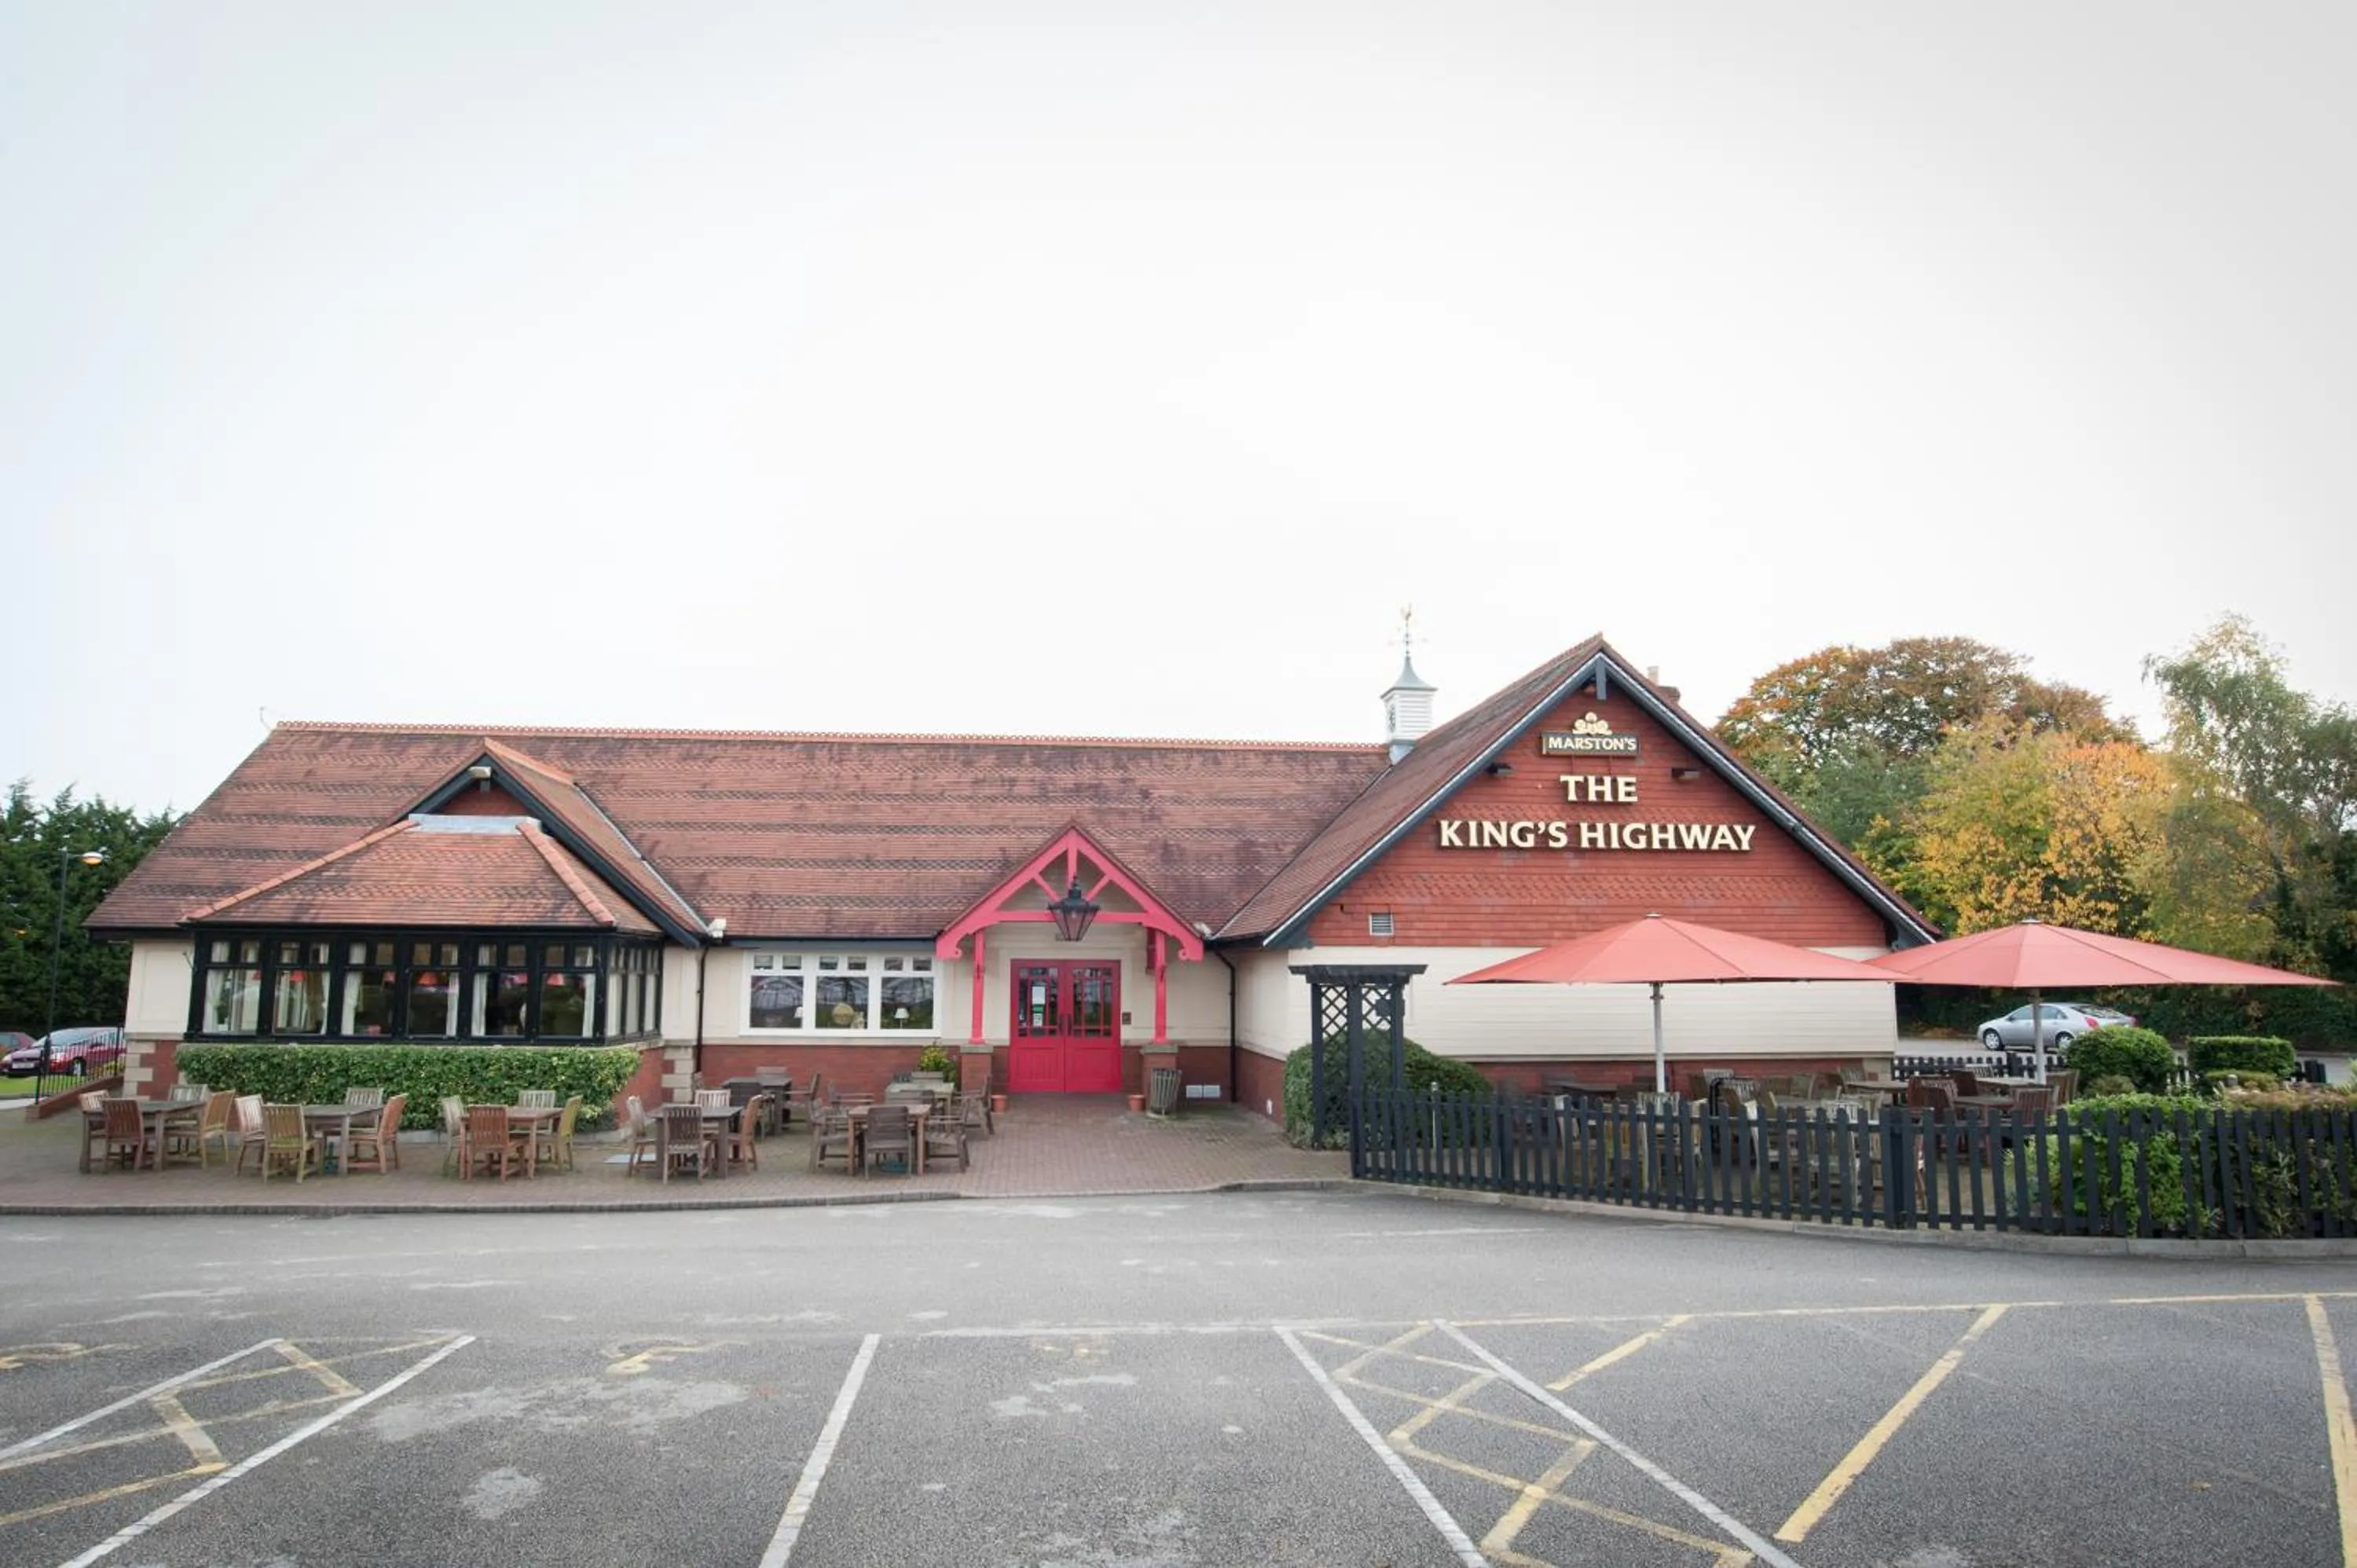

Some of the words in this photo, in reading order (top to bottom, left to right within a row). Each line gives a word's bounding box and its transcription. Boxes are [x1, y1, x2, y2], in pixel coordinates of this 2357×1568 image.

[1549, 736, 1637, 751] MARSTON'S
[1560, 775, 1637, 802] THE
[1439, 820, 1568, 848] KING'S
[1579, 822, 1756, 851] HIGHWAY
